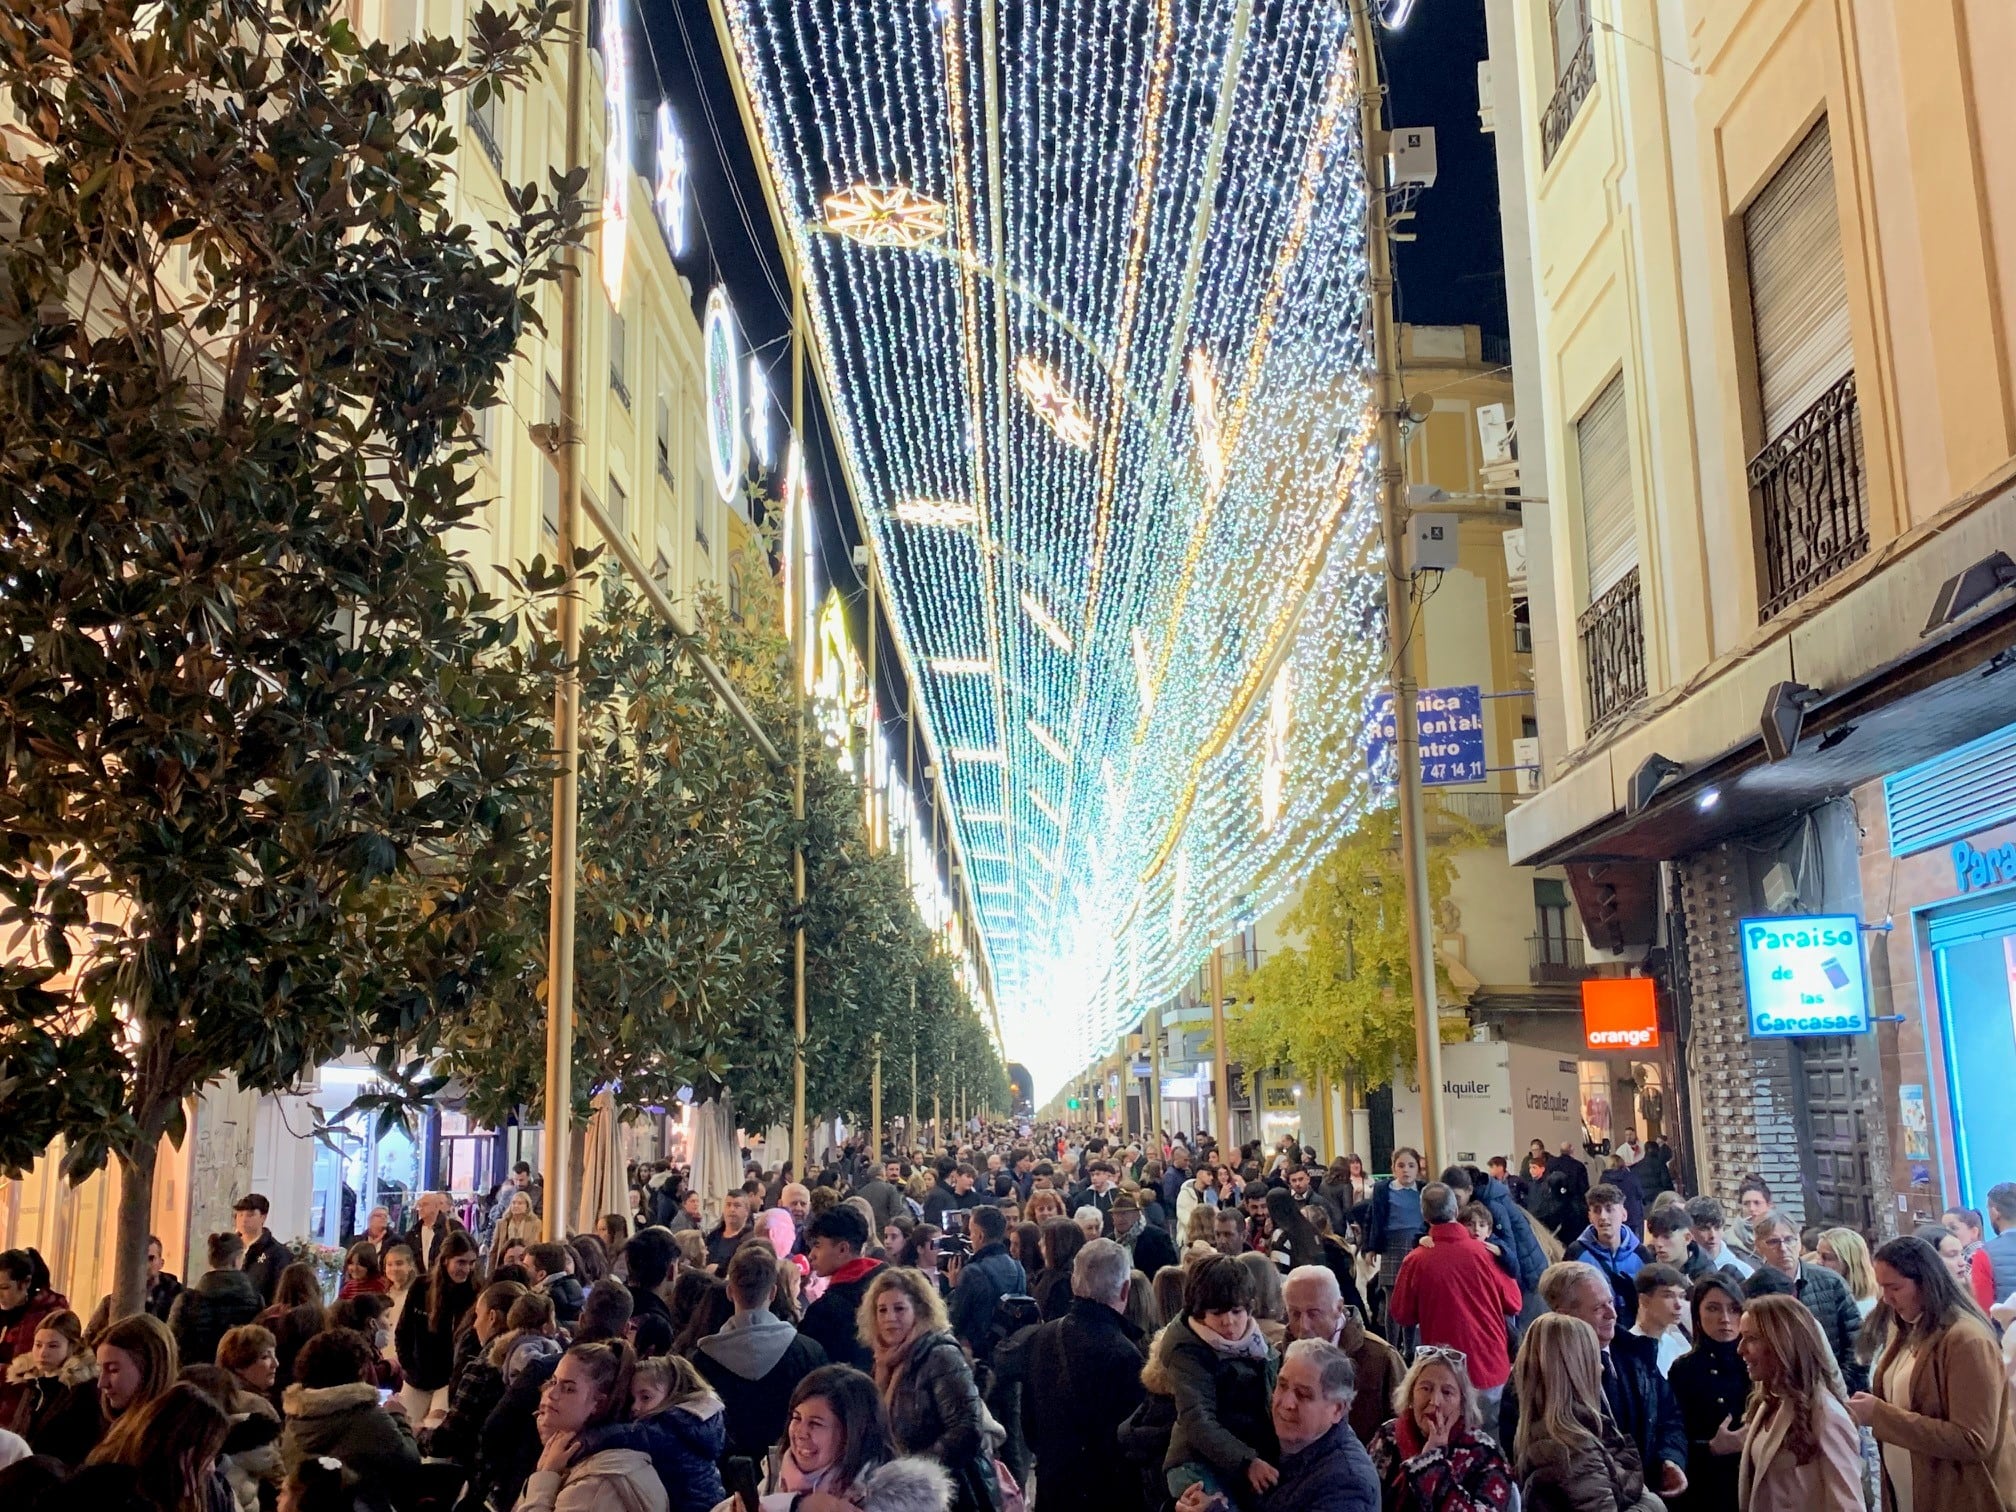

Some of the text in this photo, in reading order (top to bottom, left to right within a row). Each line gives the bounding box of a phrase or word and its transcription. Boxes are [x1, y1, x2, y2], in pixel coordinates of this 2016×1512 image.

[1431, 763, 1446, 779] 47
[1451, 762, 1465, 777] 14
[1470, 761, 1481, 775] 11
[1748, 927, 1853, 950] Paraiso
[1771, 965, 1794, 981] de
[1801, 992, 1825, 1005] las
[1756, 1013, 1861, 1032] Carcasas
[1589, 1029, 1650, 1046] orange
